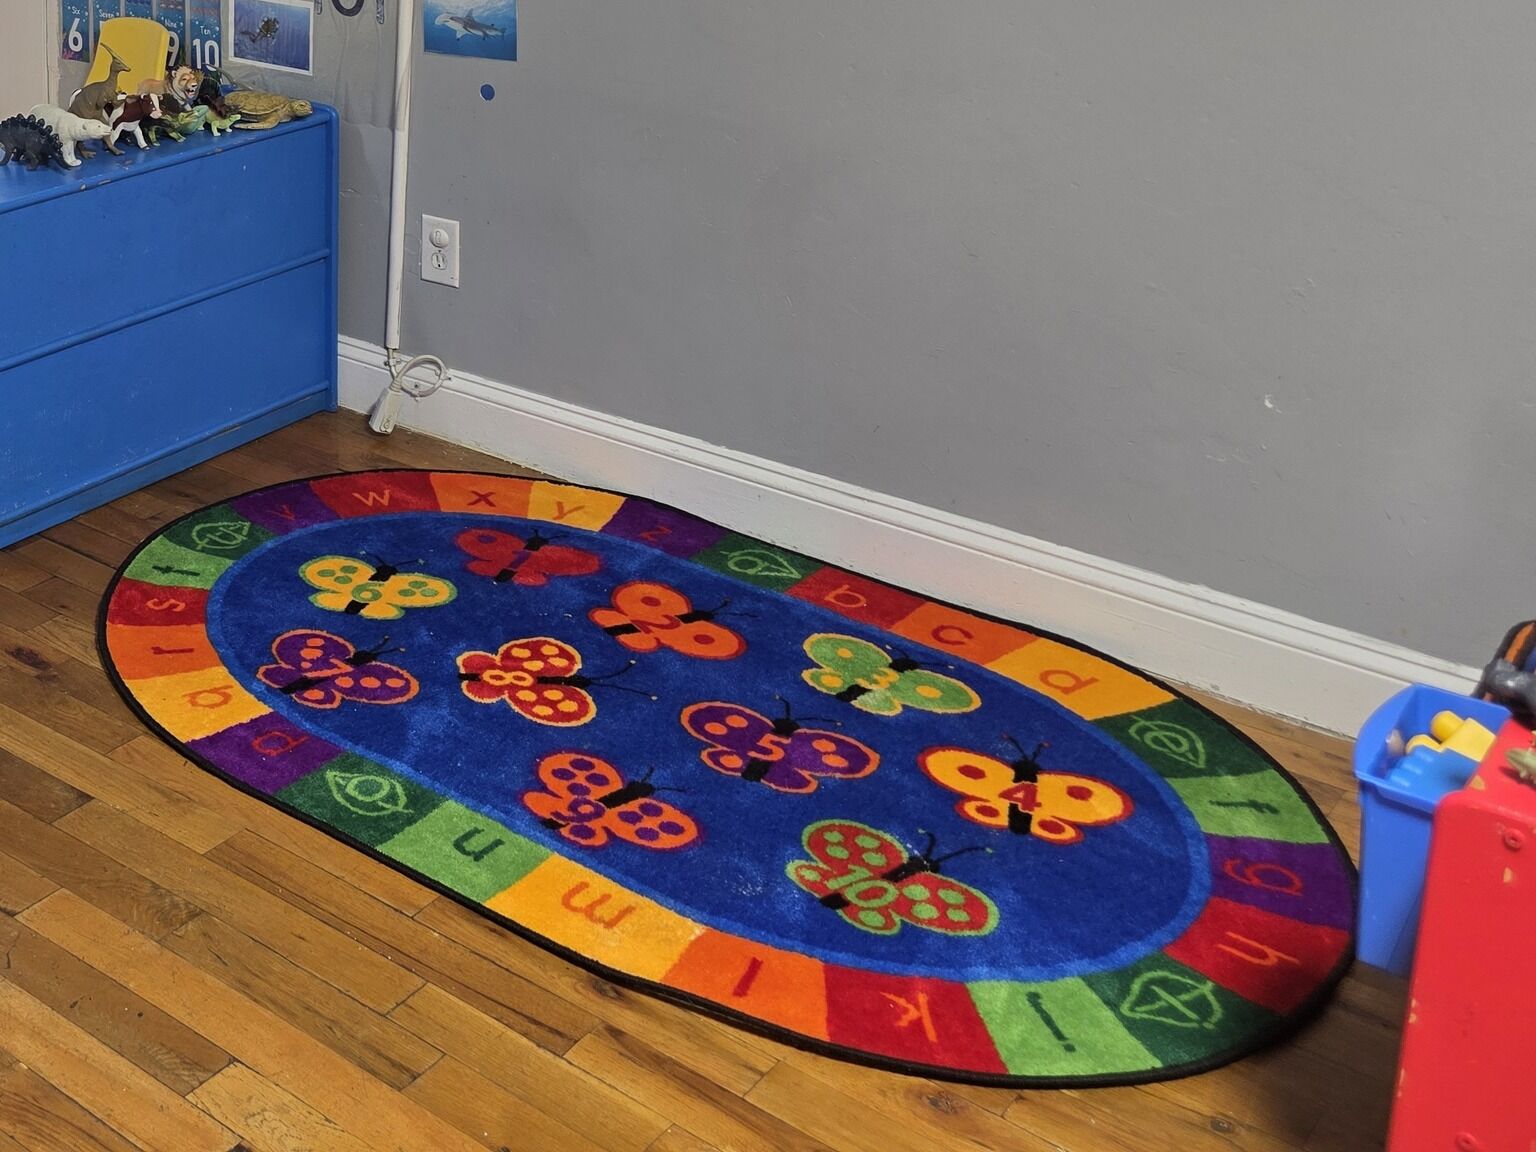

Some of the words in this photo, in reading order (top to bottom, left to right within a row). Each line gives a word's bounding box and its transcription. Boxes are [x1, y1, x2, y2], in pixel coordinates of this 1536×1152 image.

[72, 6, 81, 15] Six
[68, 18, 83, 53] 6
[200, 25, 212, 35] Ten
[192, 38, 220, 72] 10
[353, 489, 392, 507] w
[467, 490, 496, 507] x
[552, 501, 585, 521] y
[152, 564, 201, 576] t
[352, 582, 384, 601] 6
[825, 584, 867, 608] b
[145, 597, 187, 613] s
[630, 614, 681, 634] 2
[930, 624, 974, 646] c
[481, 669, 534, 686] 8
[1039, 669, 1099, 695] d
[251, 731, 312, 756] p
[746, 734, 791, 761] 5
[998, 780, 1042, 814] 4
[550, 798, 606, 823] 9
[827, 864, 899, 909] 10
[1223, 858, 1303, 896] g
[561, 881, 636, 929] m
[1218, 931, 1302, 966] h
[880, 991, 939, 1043] k
